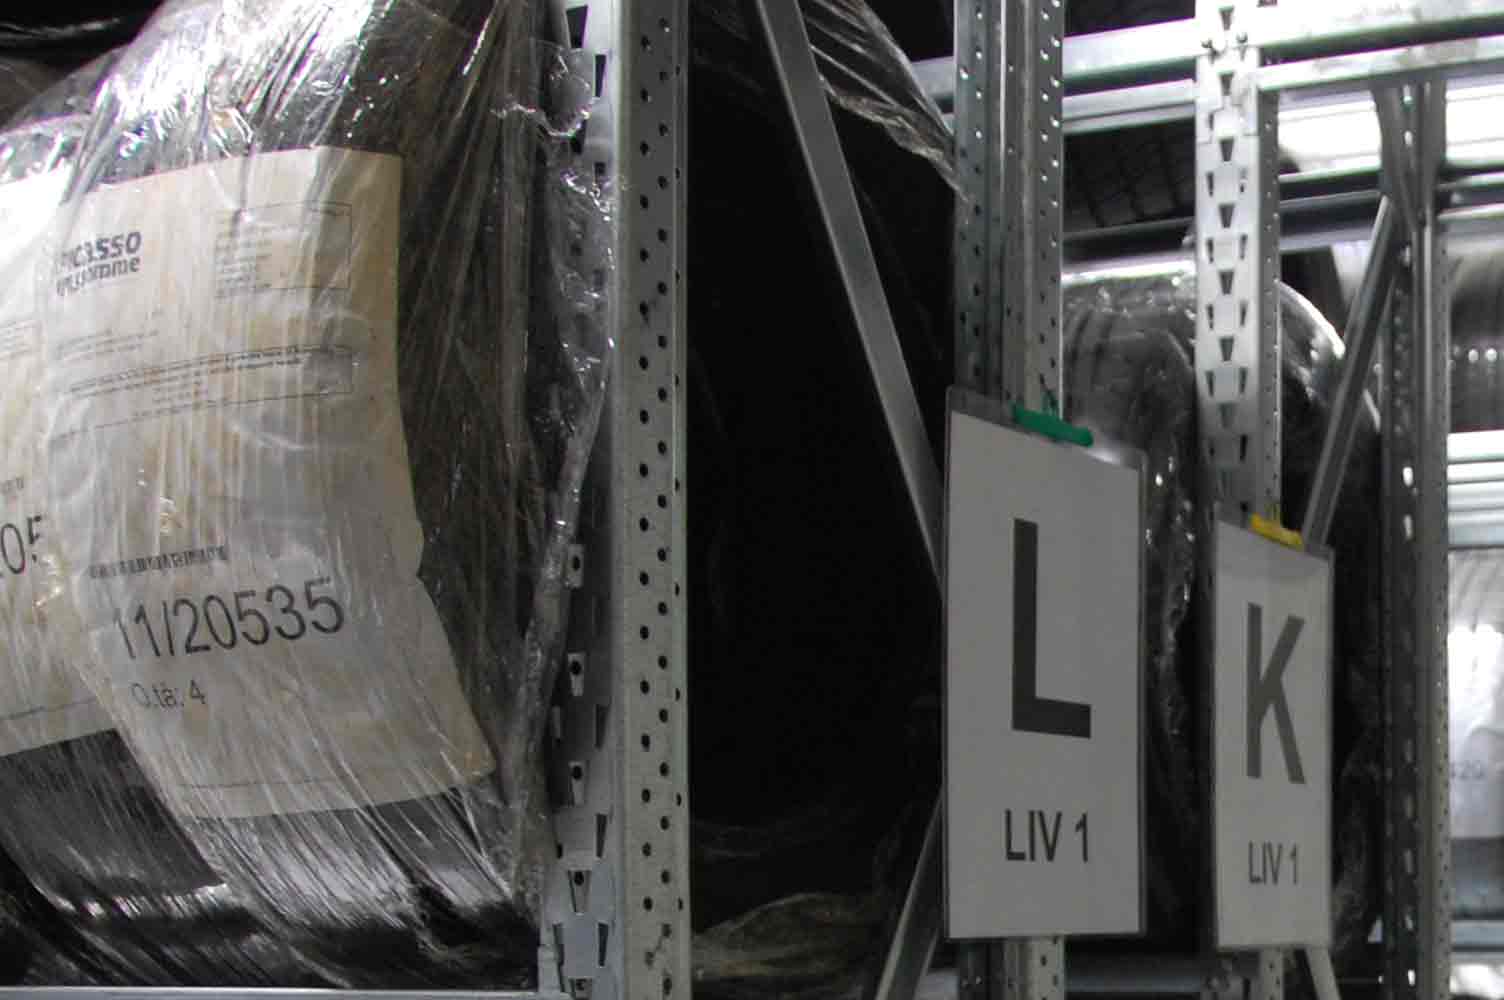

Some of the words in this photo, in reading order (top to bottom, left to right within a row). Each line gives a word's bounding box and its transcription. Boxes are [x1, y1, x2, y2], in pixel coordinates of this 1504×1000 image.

[114, 576, 344, 660] 11/20535
[1012, 518, 1092, 739] L
[189, 679, 206, 706] 4
[1246, 602, 1306, 785] K
[1005, 808, 1063, 862] LIV
[1075, 812, 1089, 863] 1
[1248, 841, 1283, 886] LIV
[1289, 843, 1298, 886] 1
